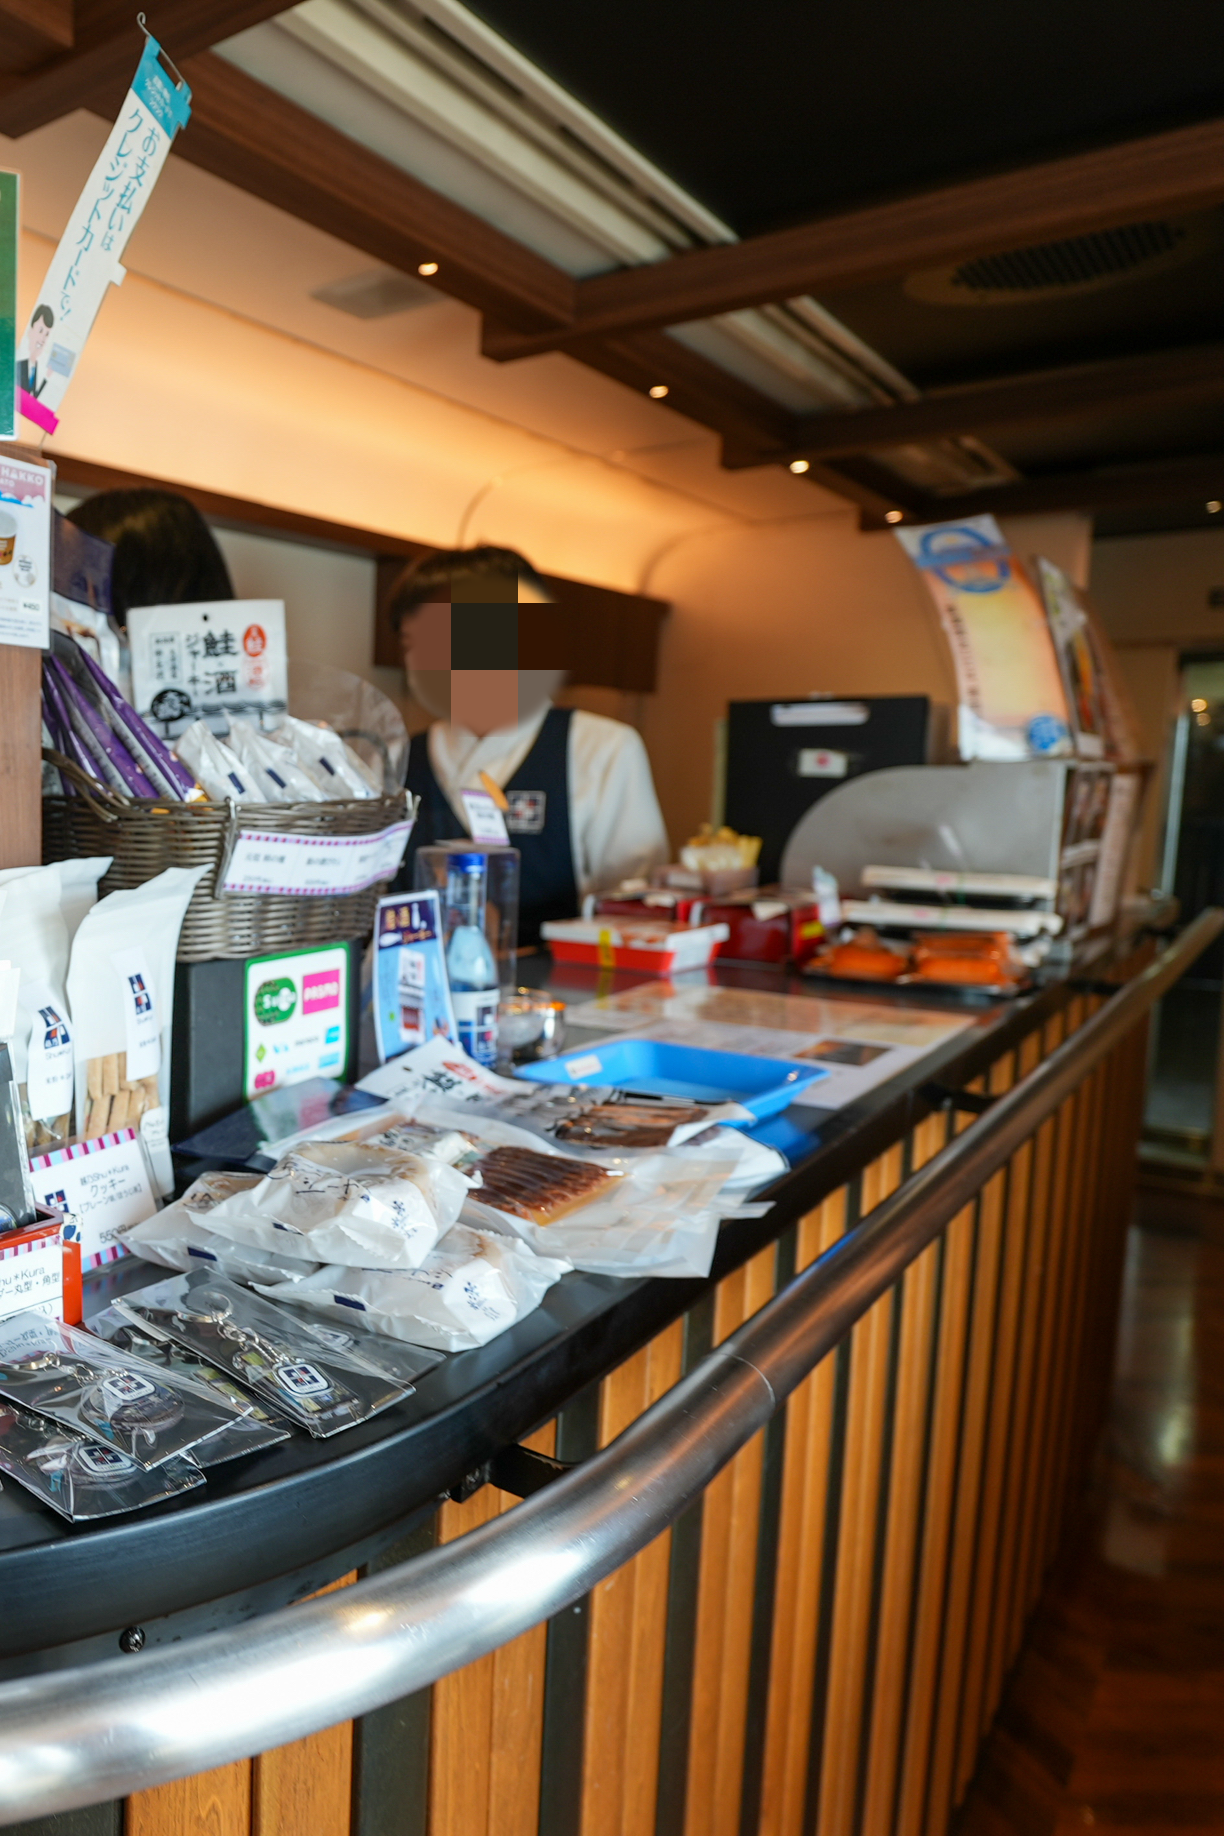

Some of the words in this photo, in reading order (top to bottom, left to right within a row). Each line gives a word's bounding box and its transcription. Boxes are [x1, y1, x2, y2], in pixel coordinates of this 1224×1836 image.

[101, 127, 160, 251] お支払いは
[1, 467, 44, 486] HAKKO
[90, 1178, 125, 1198] クッキー
